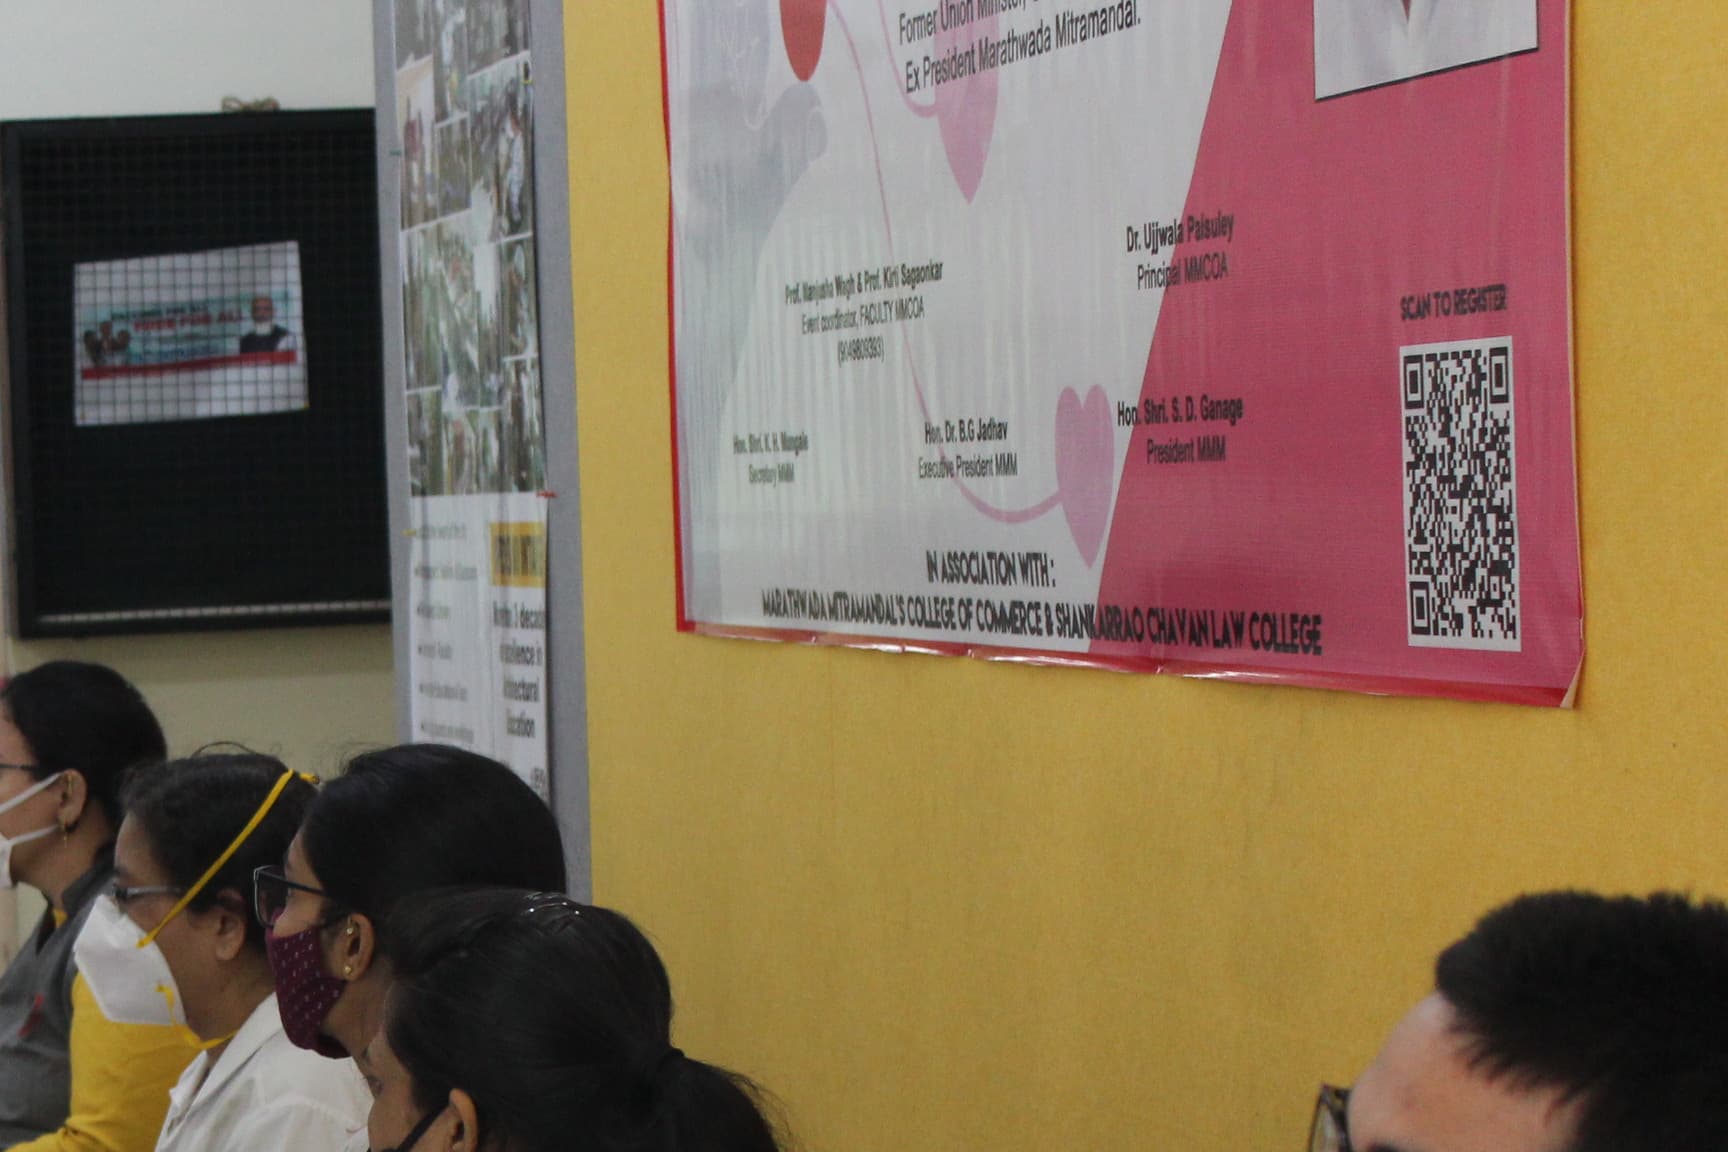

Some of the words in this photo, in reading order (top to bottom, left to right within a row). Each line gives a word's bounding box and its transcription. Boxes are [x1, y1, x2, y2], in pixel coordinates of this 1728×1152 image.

[898, 11, 938, 46] Former
[940, 0, 973, 32] Union
[905, 60, 921, 93] Ex
[922, 45, 976, 89] President
[978, 20, 1052, 73] Marathwada
[1055, 1, 1142, 49] Mitramandal.
[1126, 226, 1142, 253] Dr.
[1143, 218, 1184, 255] Ujjwala
[864, 270, 882, 293] Prof.
[1137, 256, 1182, 291] Principal
[1185, 251, 1229, 283] MMCOA
[801, 313, 821, 335] Event
[860, 299, 894, 327] FACULTY
[1400, 293, 1431, 321] SCAN
[1433, 290, 1451, 318] TO
[1453, 284, 1507, 316] REGISTER
[1118, 402, 1140, 426] Hon.
[1171, 398, 1183, 422] S.
[1185, 396, 1197, 421] D.
[1200, 394, 1244, 425] Ganage
[976, 417, 1008, 441] Jadhav
[956, 454, 993, 478] President
[995, 452, 1018, 477] MMM
[1147, 438, 1194, 464] President
[1197, 435, 1227, 462] MMM
[925, 550, 939, 584] IN
[941, 550, 1016, 587] ASSOCIATION
[1019, 551, 1049, 587] WITH
[762, 588, 826, 621] MARATHWADA
[827, 591, 906, 625] MITRAMANDAL'S
[907, 595, 957, 629] COLLEGE
[958, 597, 974, 630] OF
[976, 597, 1043, 635] COMMERCE
[1044, 601, 1054, 636] &
[1056, 602, 1145, 642] SHANKARRAO
[1147, 606, 1208, 646] CHAVAN
[1211, 610, 1246, 649] LAW
[1249, 612, 1322, 655] COLLEGE
